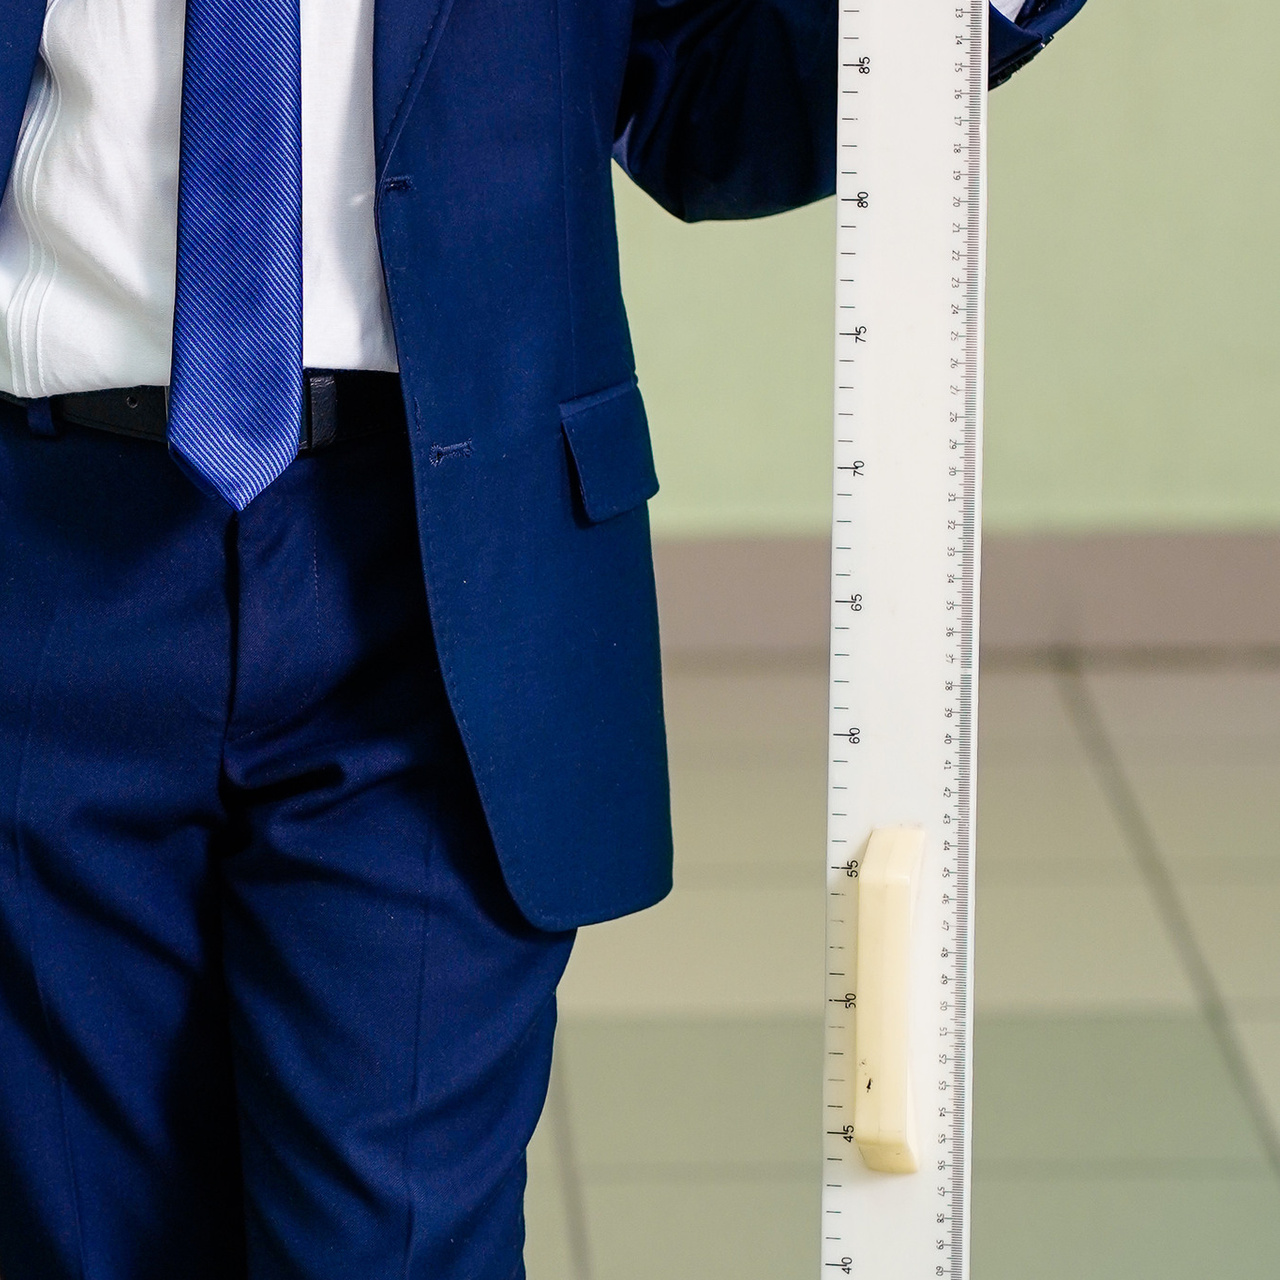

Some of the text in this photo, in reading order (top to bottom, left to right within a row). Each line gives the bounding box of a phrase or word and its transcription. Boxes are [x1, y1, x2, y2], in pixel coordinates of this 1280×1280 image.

[955, 8, 963, 18] 13
[955, 35, 962, 45] 14
[859, 57, 870, 74] 85
[955, 62, 962, 73] 15
[954, 89, 962, 100] 16
[953, 144, 961, 154] 18
[953, 170, 960, 181] 19
[857, 192, 868, 208] 80
[953, 196, 960, 207] 20
[952, 223, 960, 233] 21
[952, 250, 960, 261] 22
[951, 277, 959, 288] 23
[951, 304, 959, 314] 24
[855, 326, 867, 343] 75
[950, 358, 958, 369] 26
[949, 412, 957, 423] 28
[949, 439, 957, 450] 29
[853, 461, 864, 476] 70
[949, 466, 956, 476] 30
[948, 493, 956, 503] 31
[947, 520, 955, 530] 32
[947, 547, 955, 557] 33
[947, 574, 954, 583] 34
[851, 594, 862, 611] 65
[946, 601, 954, 611] 35
[946, 627, 953, 637] 36
[945, 681, 953, 691] 38
[945, 708, 952, 718] 39
[849, 728, 860, 744] 60
[944, 734, 951, 744] 40
[944, 760, 951, 770] 41
[943, 787, 950, 797] 42
[943, 814, 950, 824] 43
[943, 840, 950, 851] 44
[847, 860, 858, 878] 55
[942, 867, 949, 878] 45
[942, 893, 949, 904] 46
[941, 947, 948, 958] 48
[940, 974, 947, 985] 49
[845, 993, 856, 1009] 50
[939, 1054, 946, 1064] 52
[938, 1080, 946, 1091] 53
[938, 1107, 946, 1117] 54
[843, 1125, 854, 1143] 45
[938, 1160, 945, 1171] 56
[938, 1186, 945, 1197] 57
[937, 1213, 944, 1223] 58
[936, 1240, 944, 1250] 59
[841, 1257, 852, 1274] 40
[936, 1266, 943, 1276] 60
